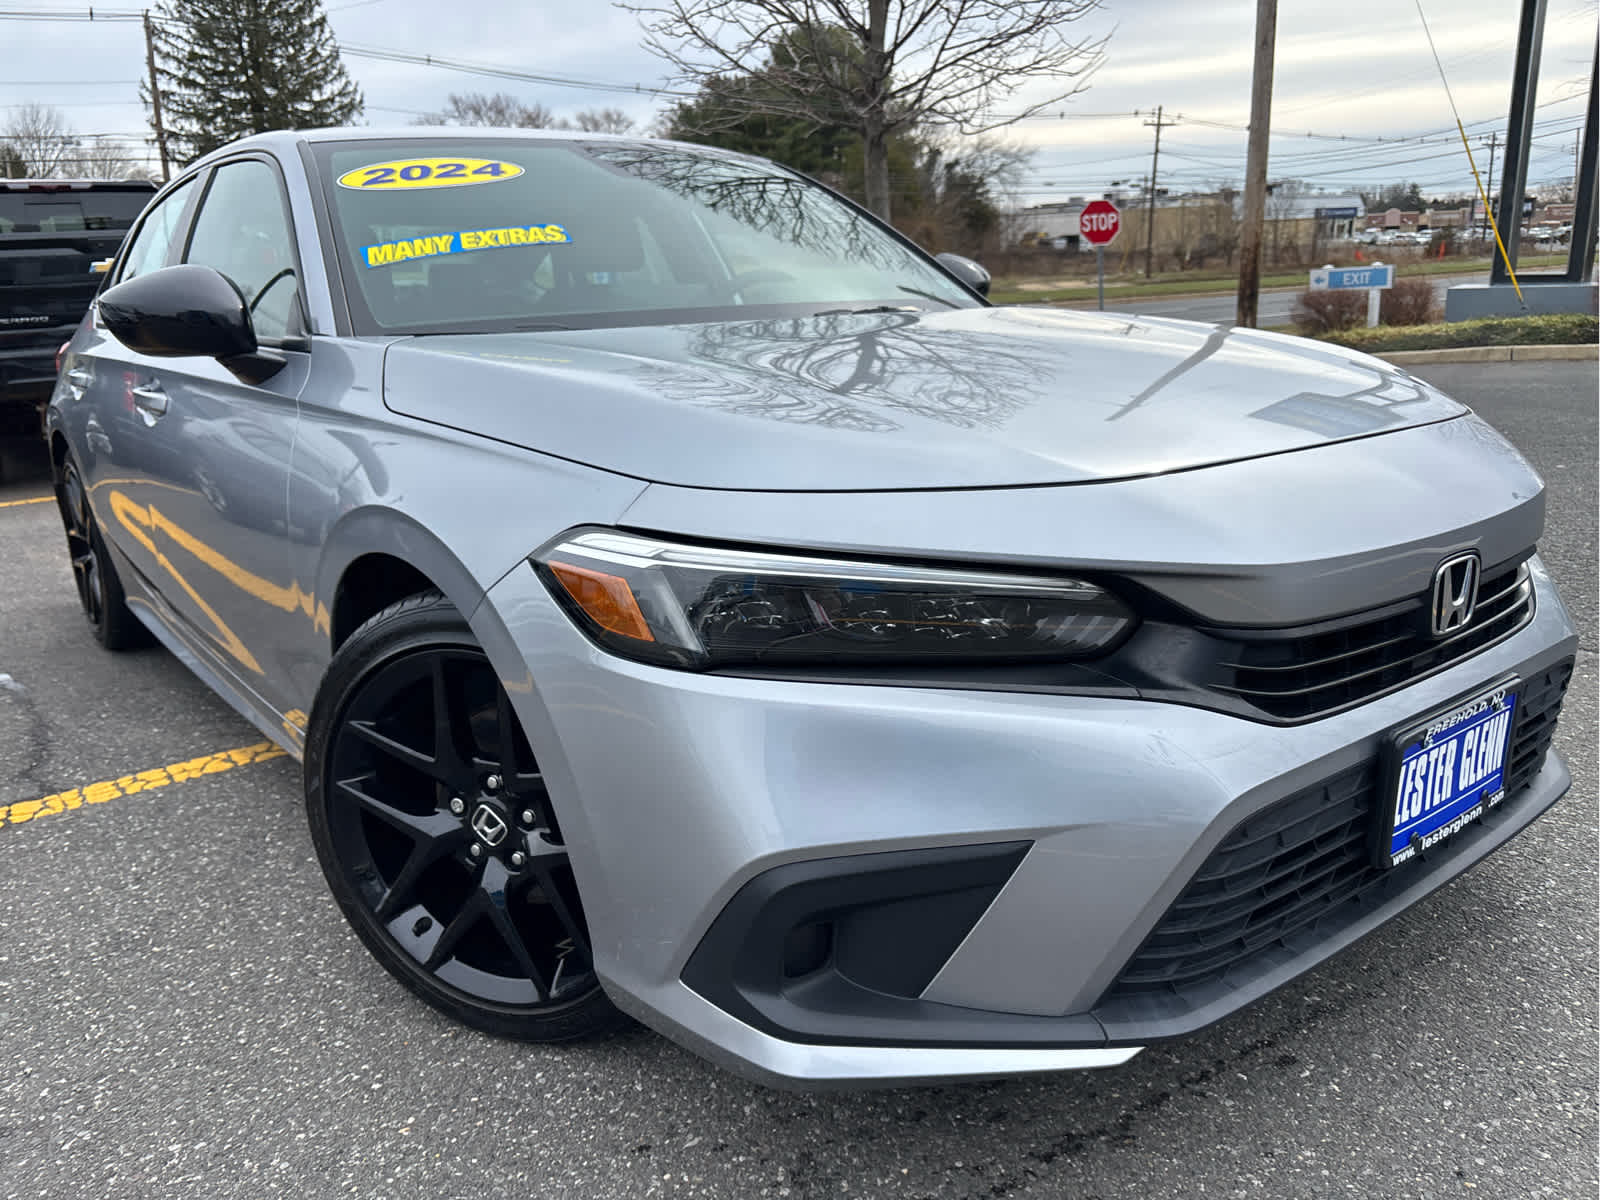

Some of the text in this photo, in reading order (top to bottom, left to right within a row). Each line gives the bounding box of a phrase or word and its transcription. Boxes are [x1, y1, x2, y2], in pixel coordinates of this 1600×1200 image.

[362, 163, 506, 186] 2024
[1082, 213, 1117, 232] STOP
[367, 225, 567, 266] MANY EXTRAS
[1343, 272, 1371, 286] EXIT
[1394, 710, 1510, 827] LESTER GLENN
